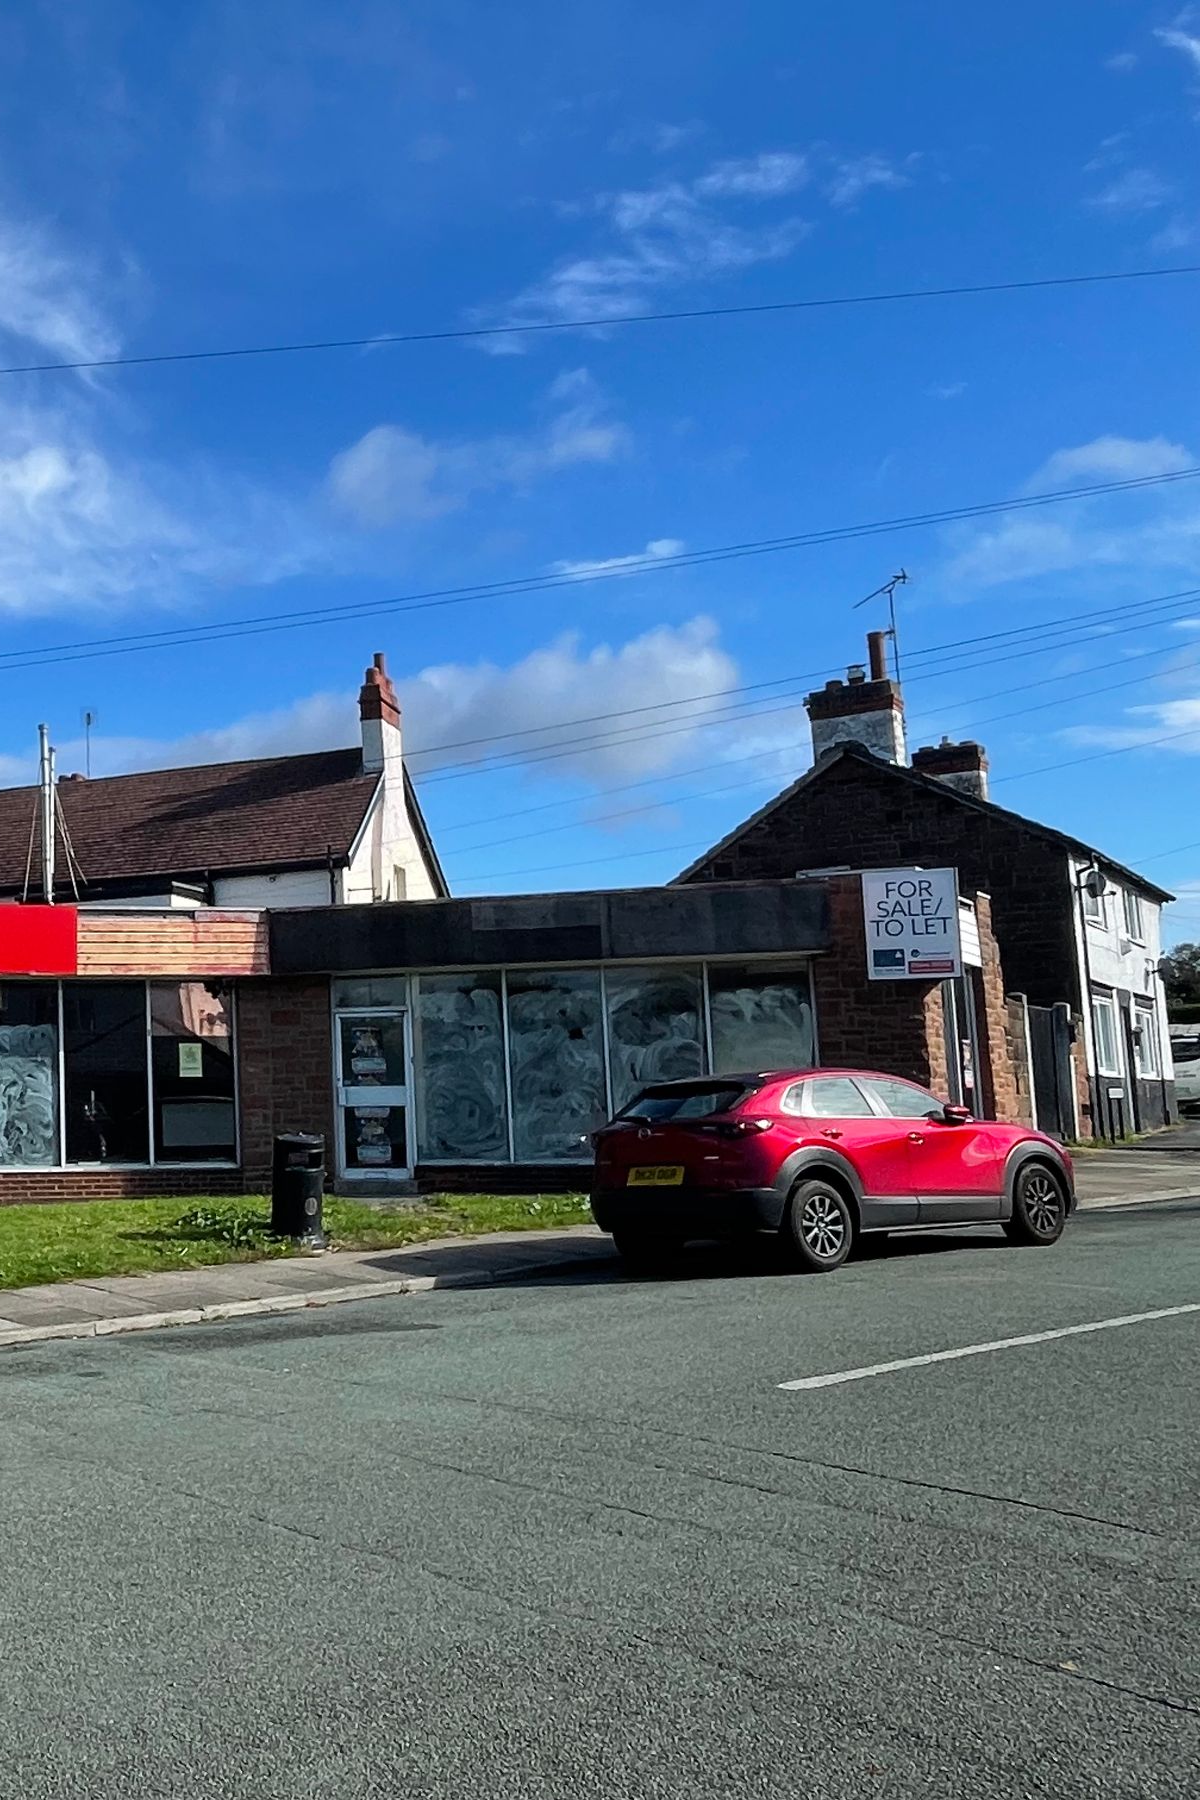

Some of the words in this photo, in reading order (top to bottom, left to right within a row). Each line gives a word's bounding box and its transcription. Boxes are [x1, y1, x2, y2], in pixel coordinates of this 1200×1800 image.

[885, 880, 933, 899] FOR
[877, 897, 943, 918] SALE/
[869, 919, 904, 937] TO
[911, 917, 952, 936] LET
